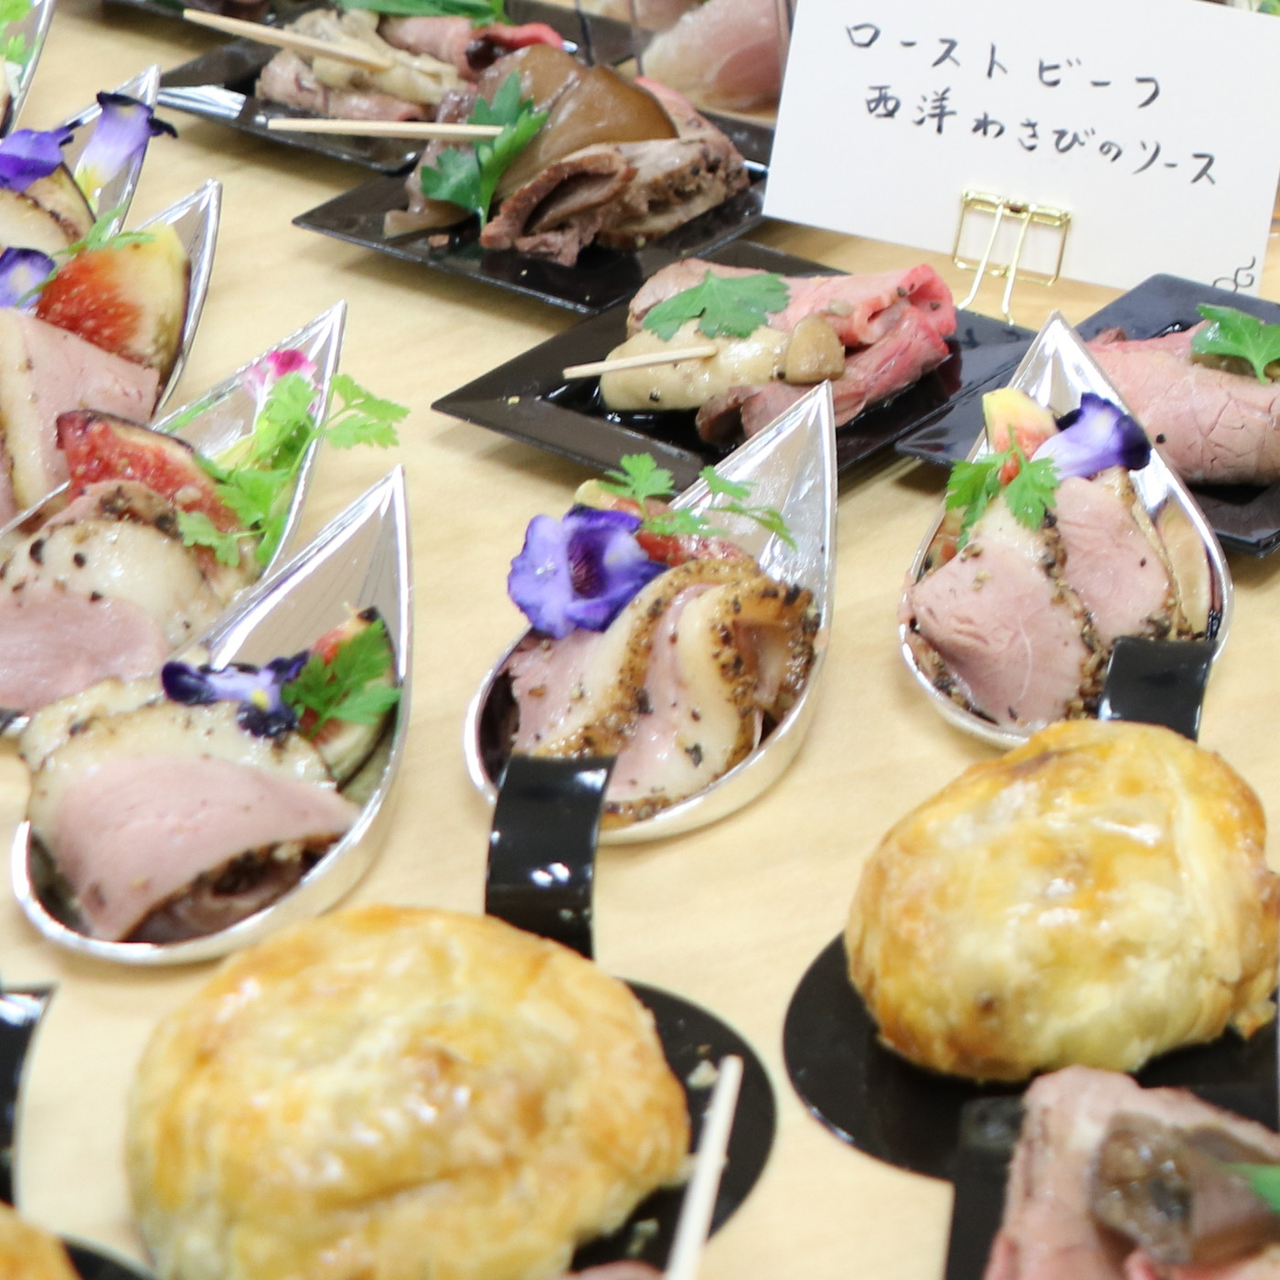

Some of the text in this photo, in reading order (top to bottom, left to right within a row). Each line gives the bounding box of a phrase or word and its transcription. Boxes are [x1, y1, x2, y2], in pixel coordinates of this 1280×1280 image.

[846, 22, 1161, 109] ローストビーフ
[865, 84, 1216, 185] 西洋わさびのソース
